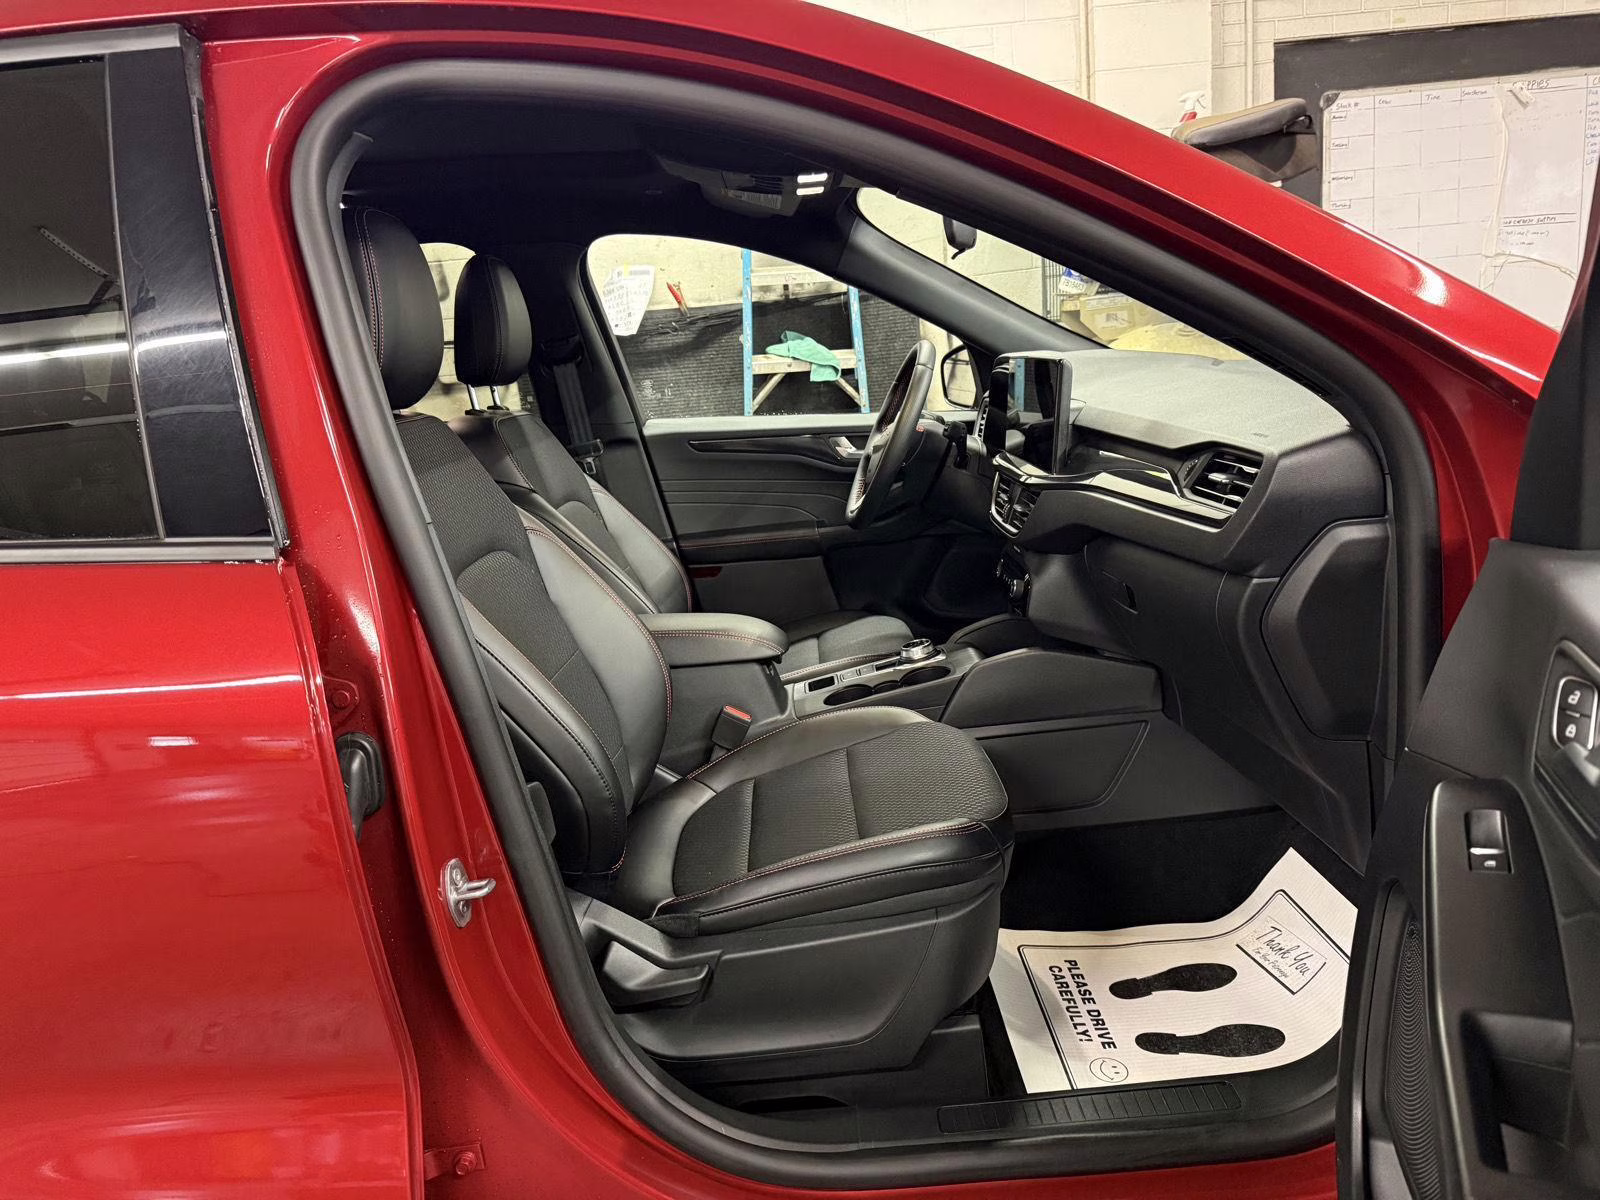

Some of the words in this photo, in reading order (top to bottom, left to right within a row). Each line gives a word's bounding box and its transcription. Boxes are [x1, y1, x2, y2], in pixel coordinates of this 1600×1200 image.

[1336, 102, 1352, 111] Stock
[1256, 926, 1300, 958] Thank
[1289, 952, 1313, 975] You
[1049, 965, 1093, 1042] CAREFULLY!
[1064, 960, 1096, 1005] PLEASE
[1086, 1009, 1117, 1049] DRIVE
